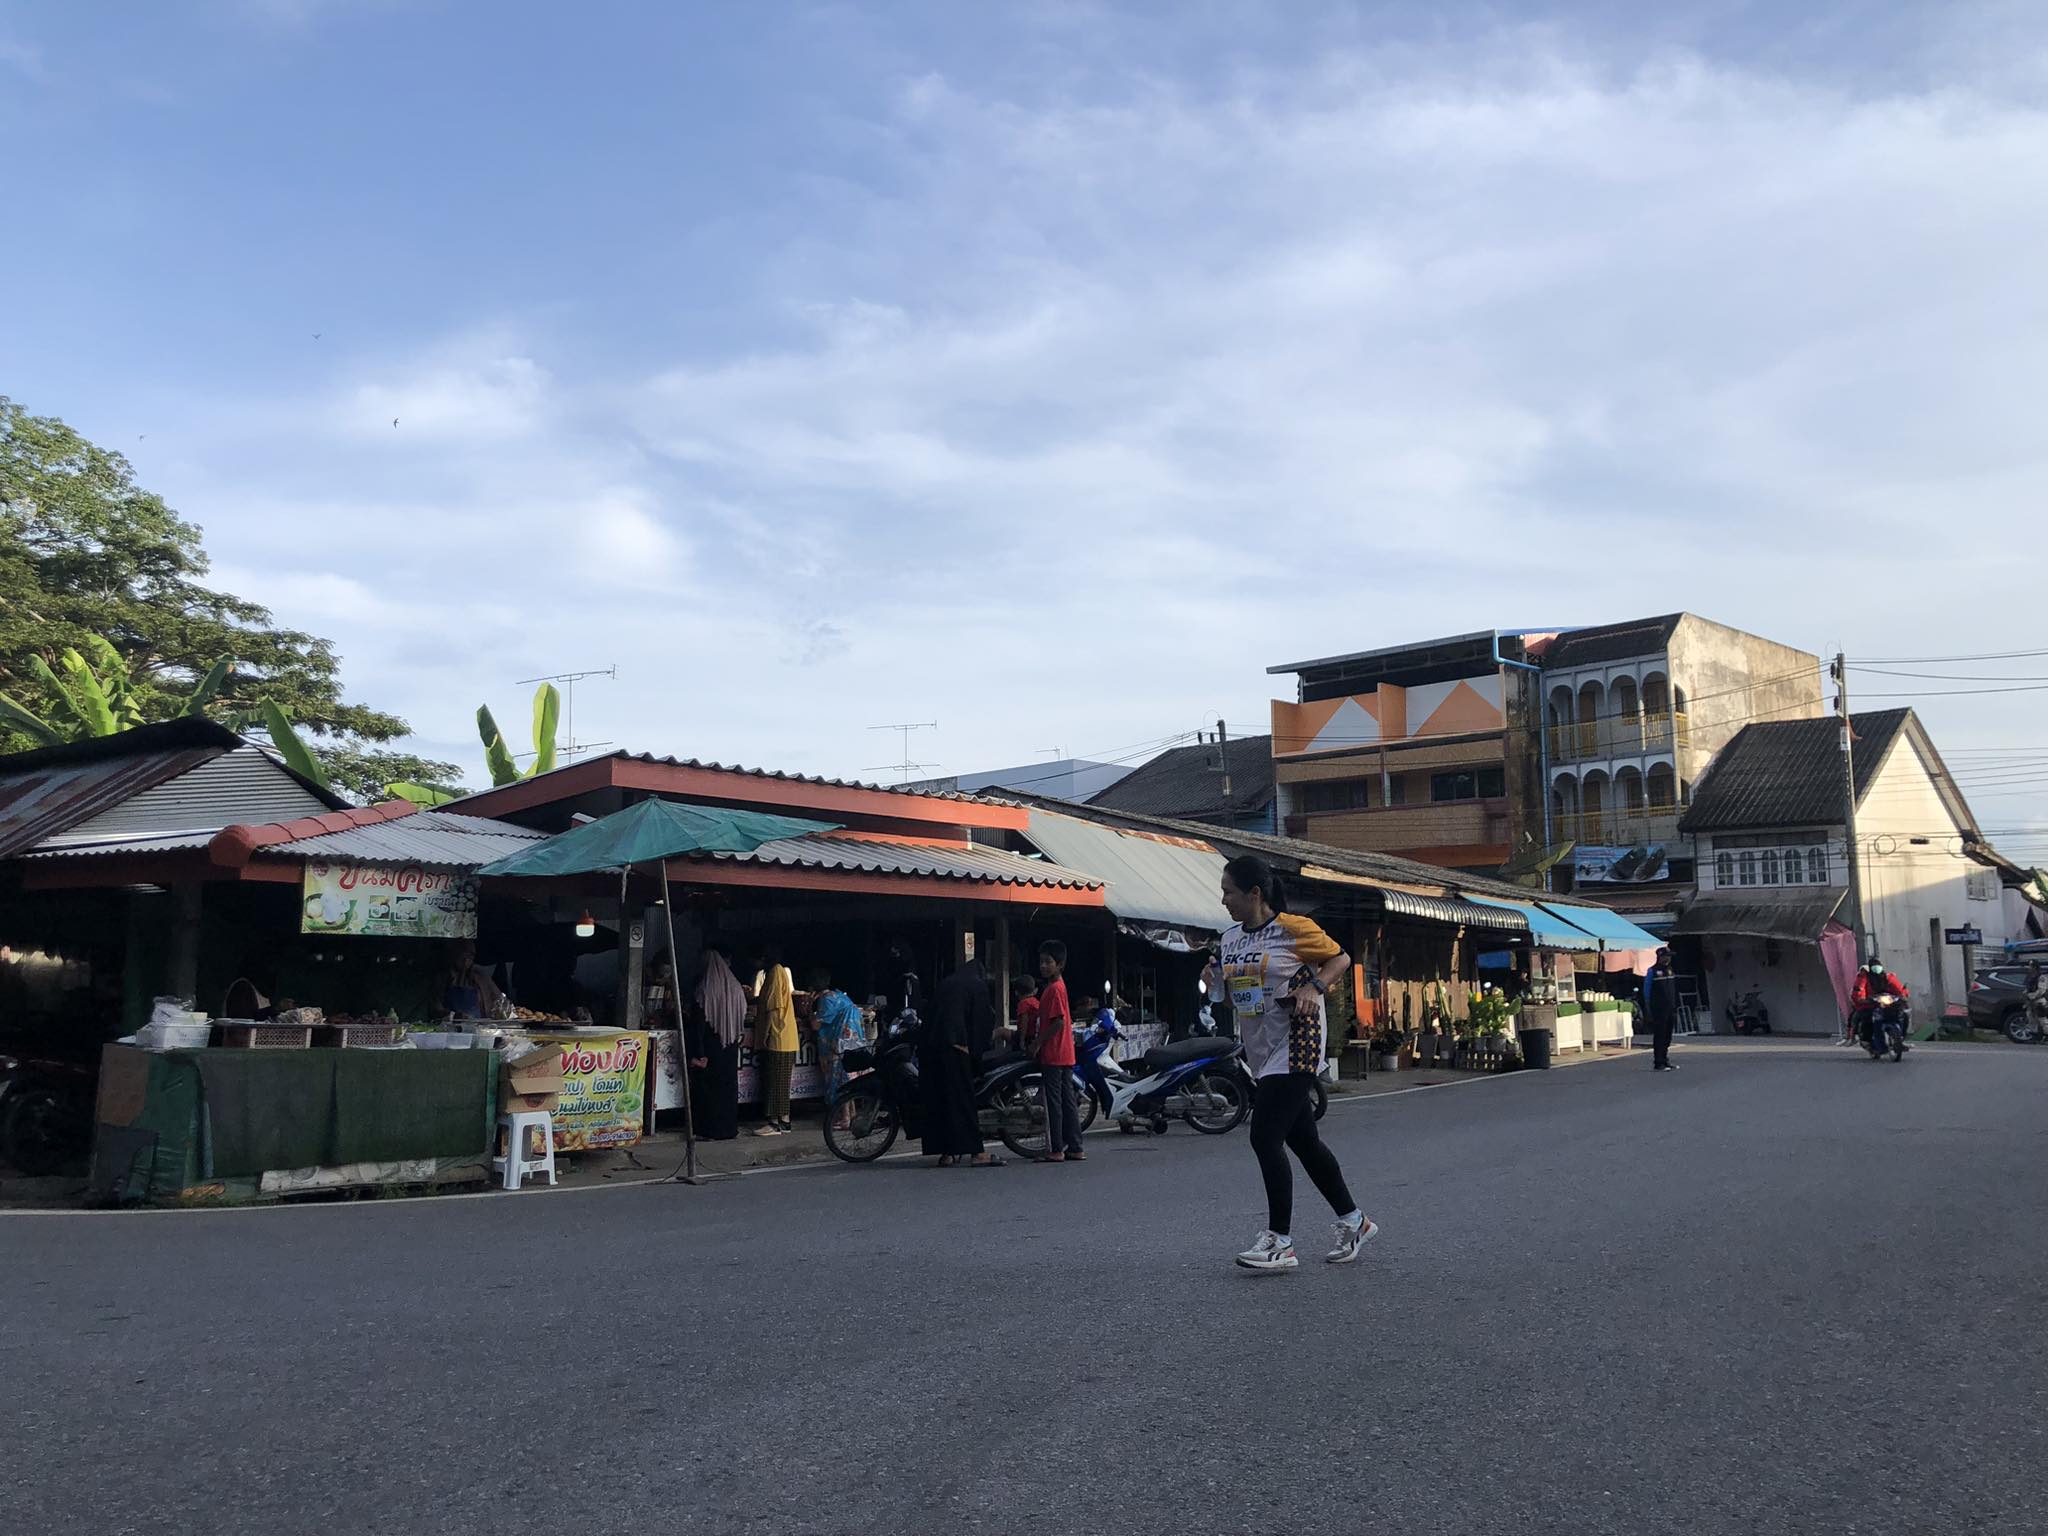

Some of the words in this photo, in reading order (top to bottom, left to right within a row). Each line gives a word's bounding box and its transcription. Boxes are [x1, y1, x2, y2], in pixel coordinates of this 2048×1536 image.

[339, 864, 450, 893] ขนมครก
[1224, 953, 1262, 965] SK-CC
[552, 1096, 615, 1117] นมไข่หงส์
